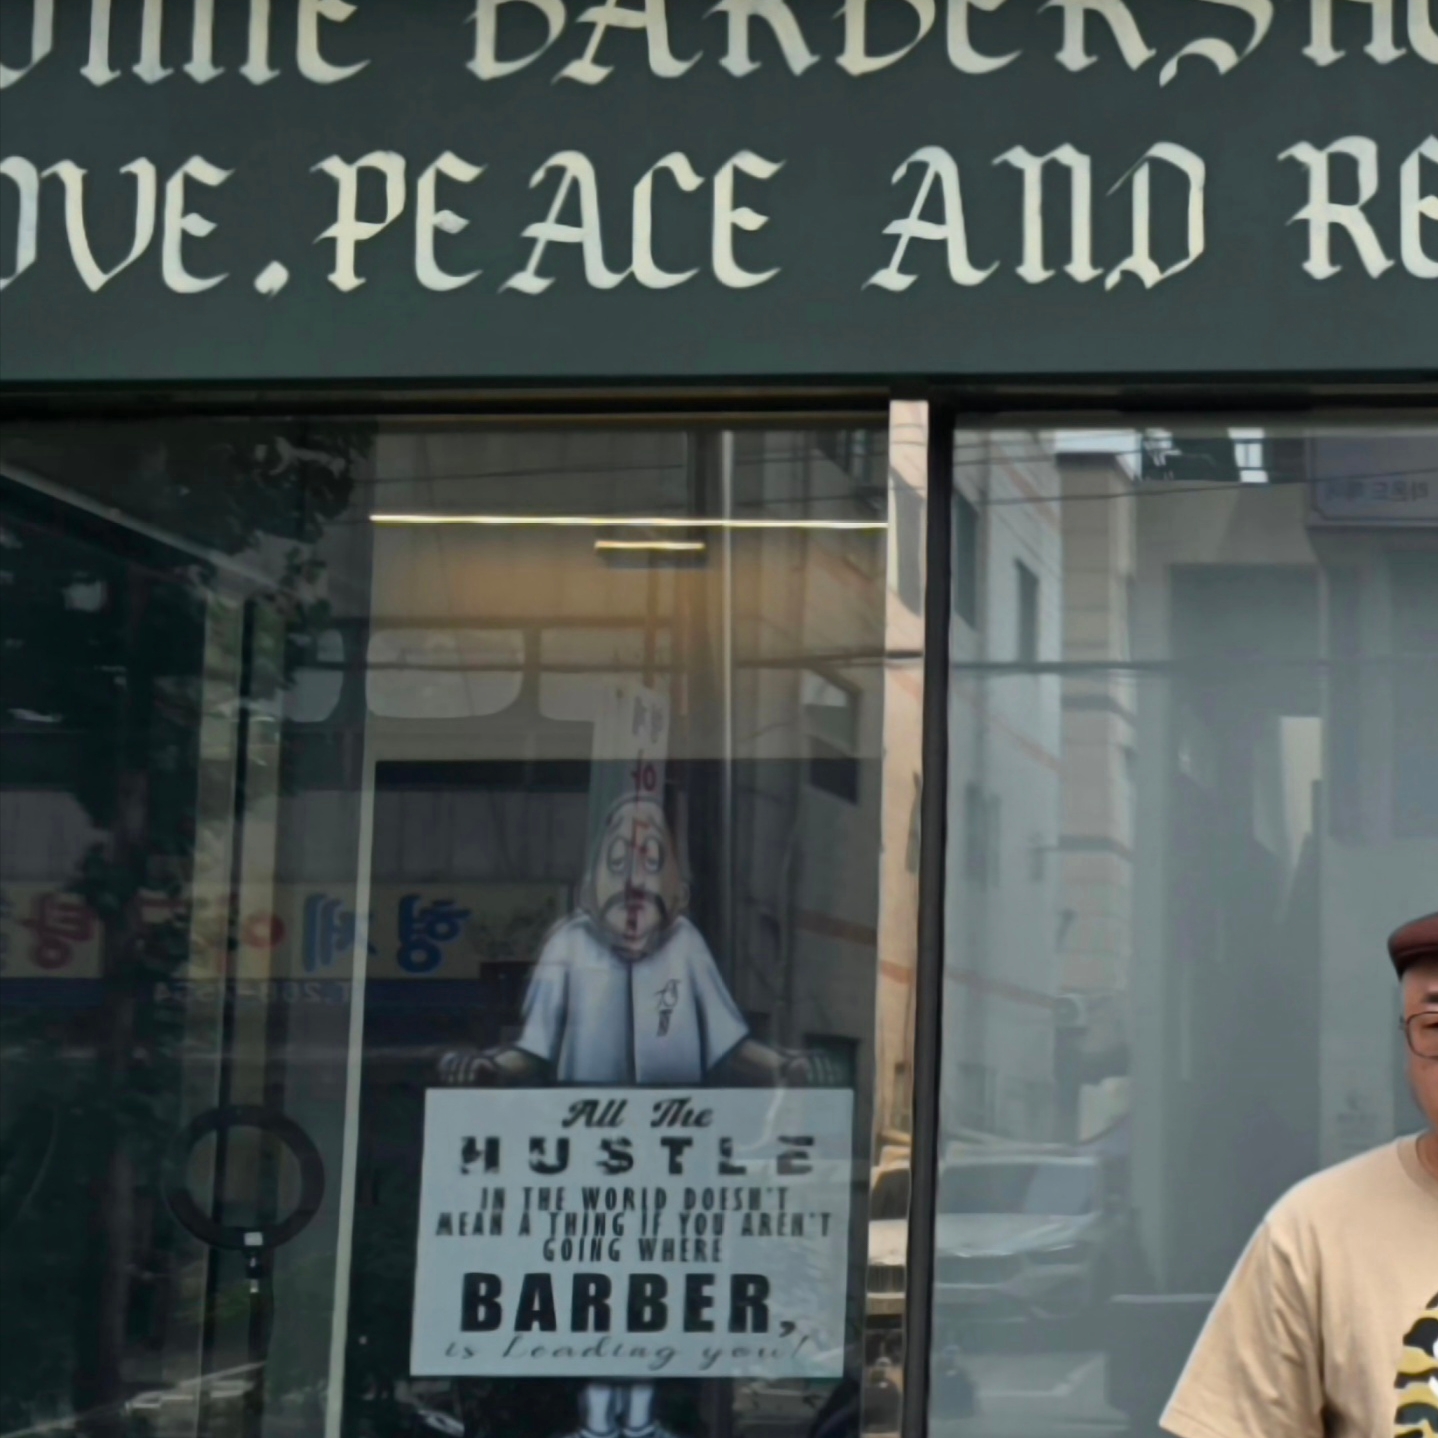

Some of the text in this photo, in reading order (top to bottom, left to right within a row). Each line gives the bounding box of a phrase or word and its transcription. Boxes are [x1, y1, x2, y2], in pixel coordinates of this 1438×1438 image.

[862, 142, 1206, 291] AND
[562, 1096, 713, 1129] All The
[459, 1135, 816, 1176] HUSTLE
[480, 1187, 789, 1211] IN THE WORLD DOESN'T
[435, 1212, 832, 1237] MEAN A THING IF YOU AREN'T
[542, 1237, 723, 1263] GOING WHERE
[460, 1272, 797, 1338] BARBER,
[444, 1341, 481, 1360] is
